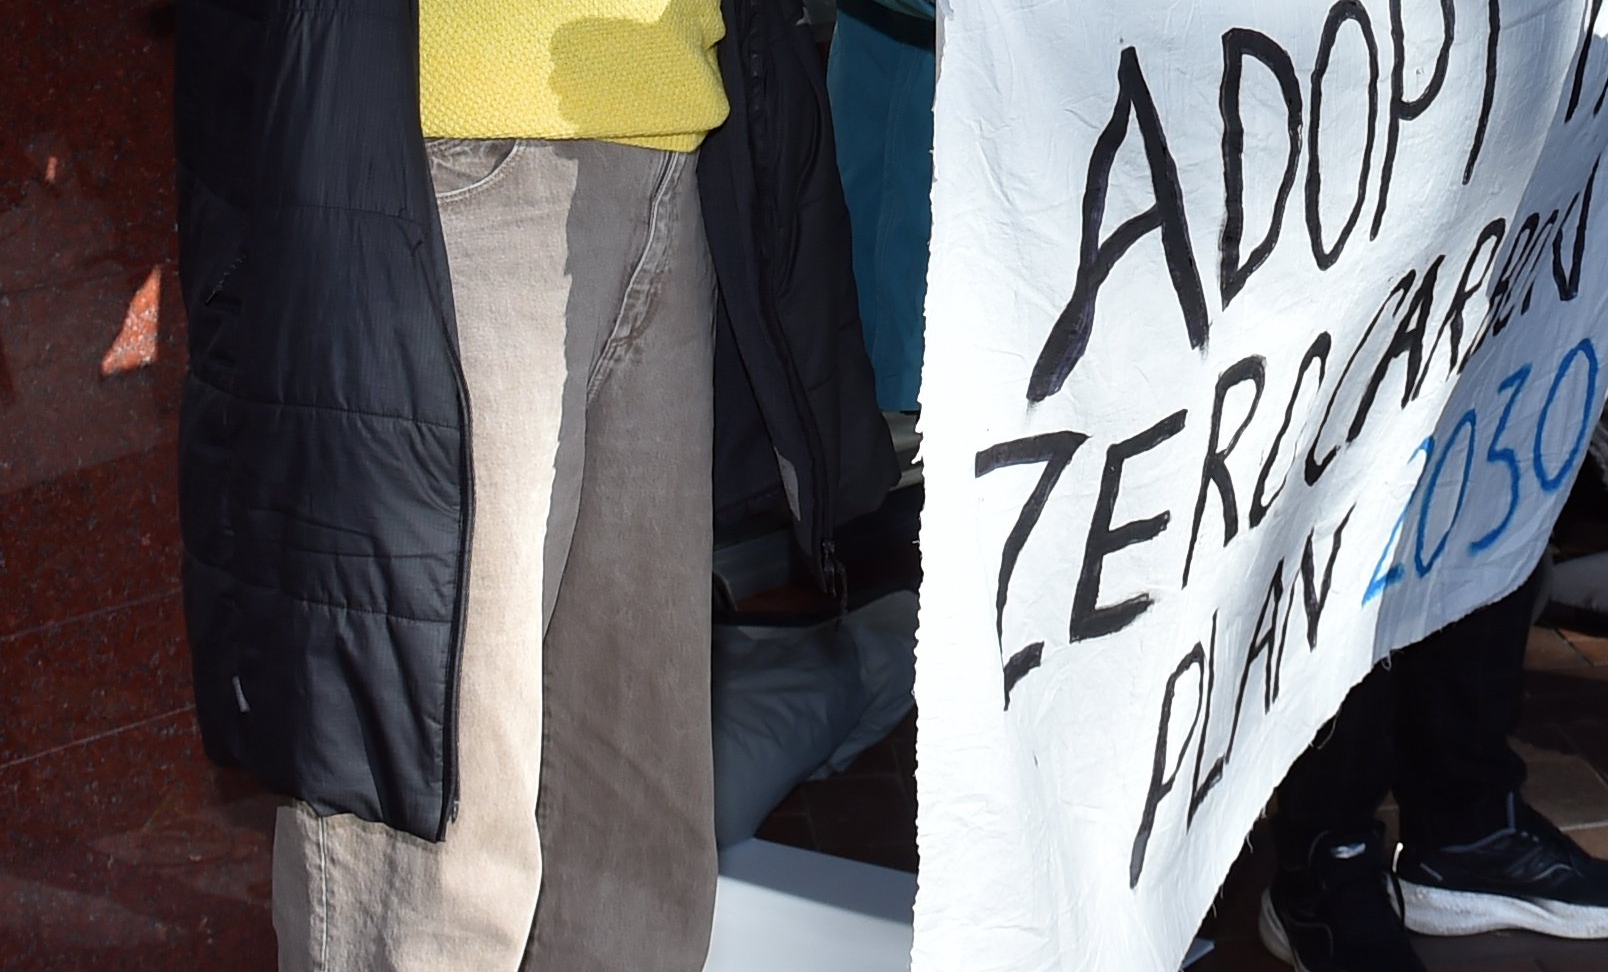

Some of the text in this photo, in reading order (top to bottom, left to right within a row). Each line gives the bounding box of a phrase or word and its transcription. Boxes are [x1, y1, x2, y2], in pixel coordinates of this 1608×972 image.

[975, 331, 1331, 711] ZERO
[1130, 337, 1599, 889] PLAN 2030
